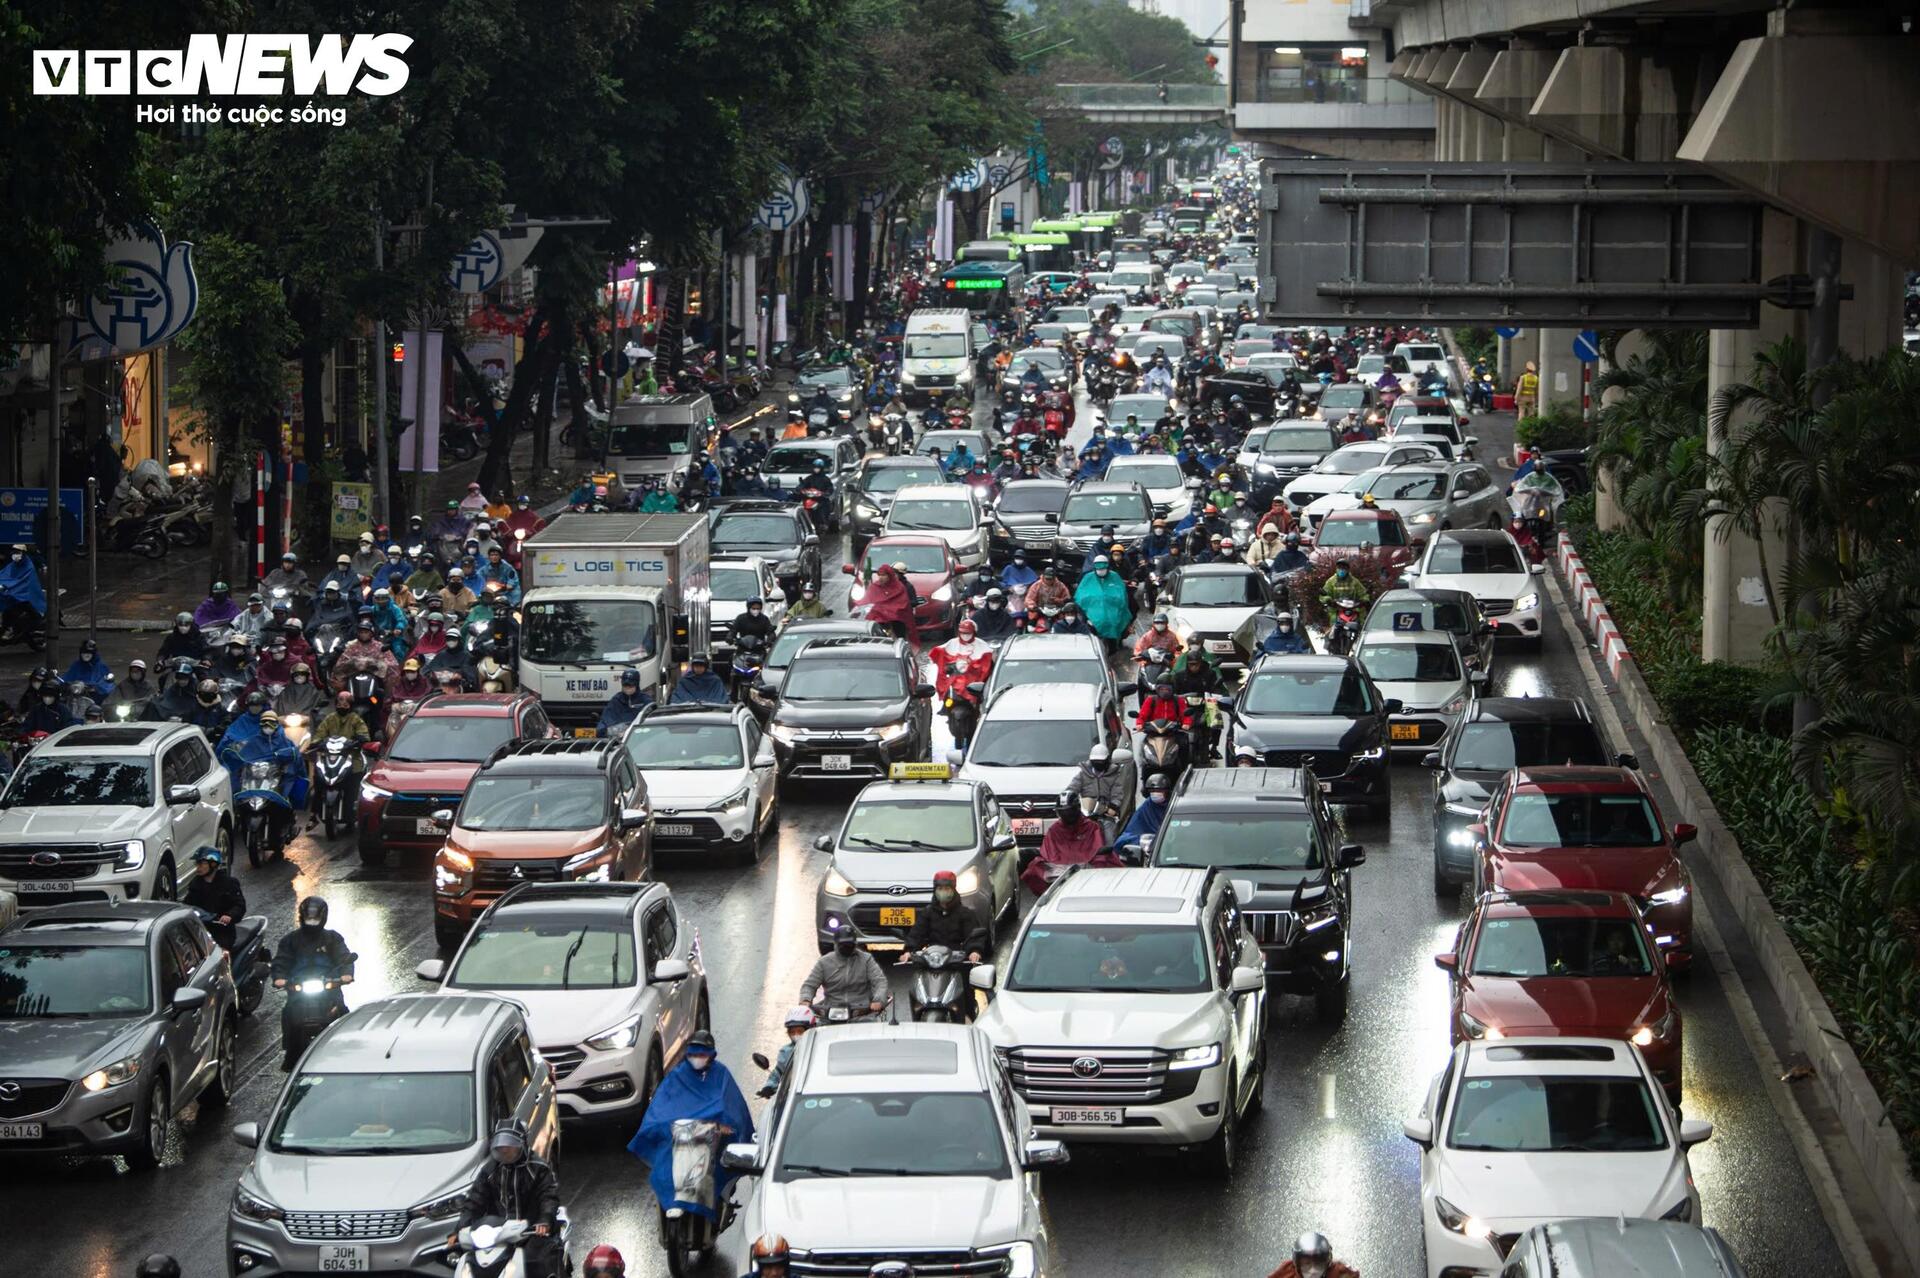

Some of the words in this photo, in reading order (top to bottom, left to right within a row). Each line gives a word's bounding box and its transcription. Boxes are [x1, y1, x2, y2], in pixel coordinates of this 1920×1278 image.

[574, 560, 664, 572] LOGISTICS
[566, 680, 576, 691] XE
[578, 679, 592, 691] THƯ
[593, 678, 608, 691] BÁO
[1057, 1111, 1117, 1122] 30B-566.56
[333, 1247, 355, 1258] 30H
[323, 1259, 363, 1270] 604.91
